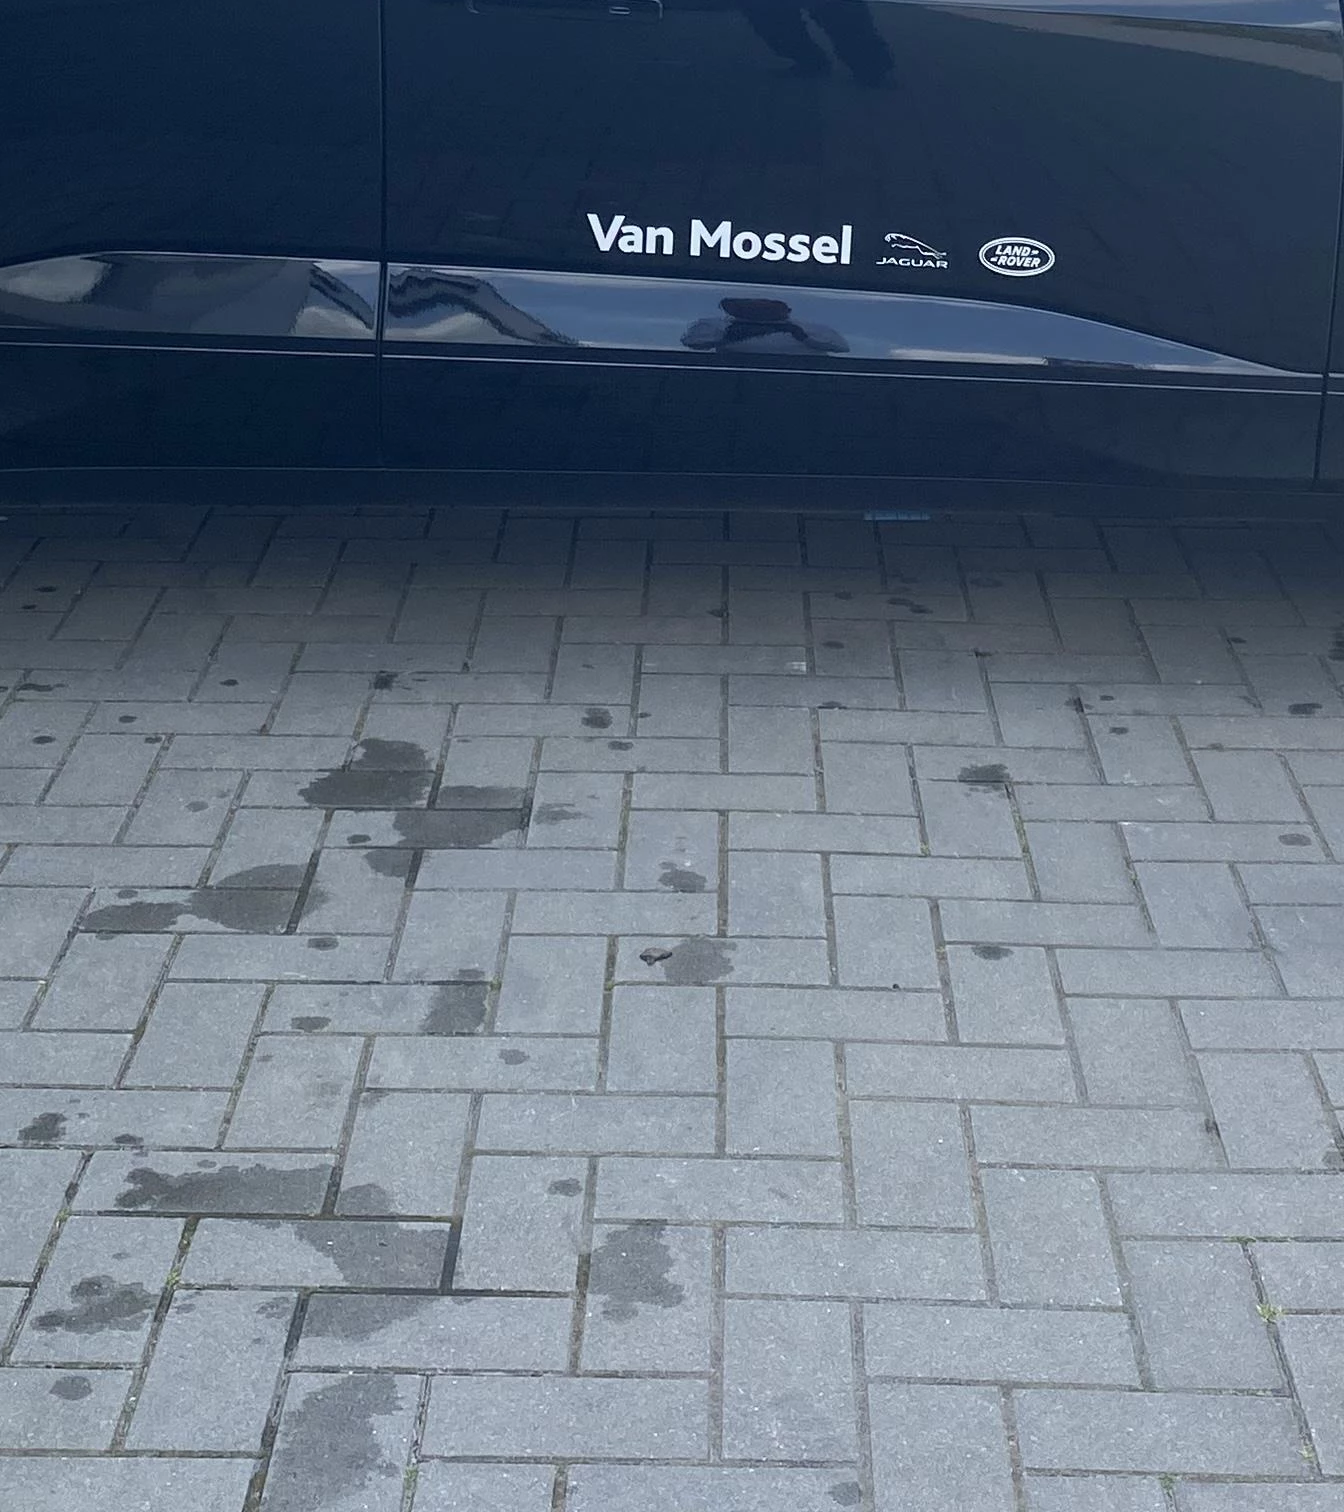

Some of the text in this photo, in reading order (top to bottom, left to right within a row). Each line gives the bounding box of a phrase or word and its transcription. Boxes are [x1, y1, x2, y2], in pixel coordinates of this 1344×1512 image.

[586, 212, 853, 265] Van Mossel
[994, 244, 1033, 257] LAND
[875, 256, 949, 269] JAGUAR
[996, 256, 1042, 268] ROVER
